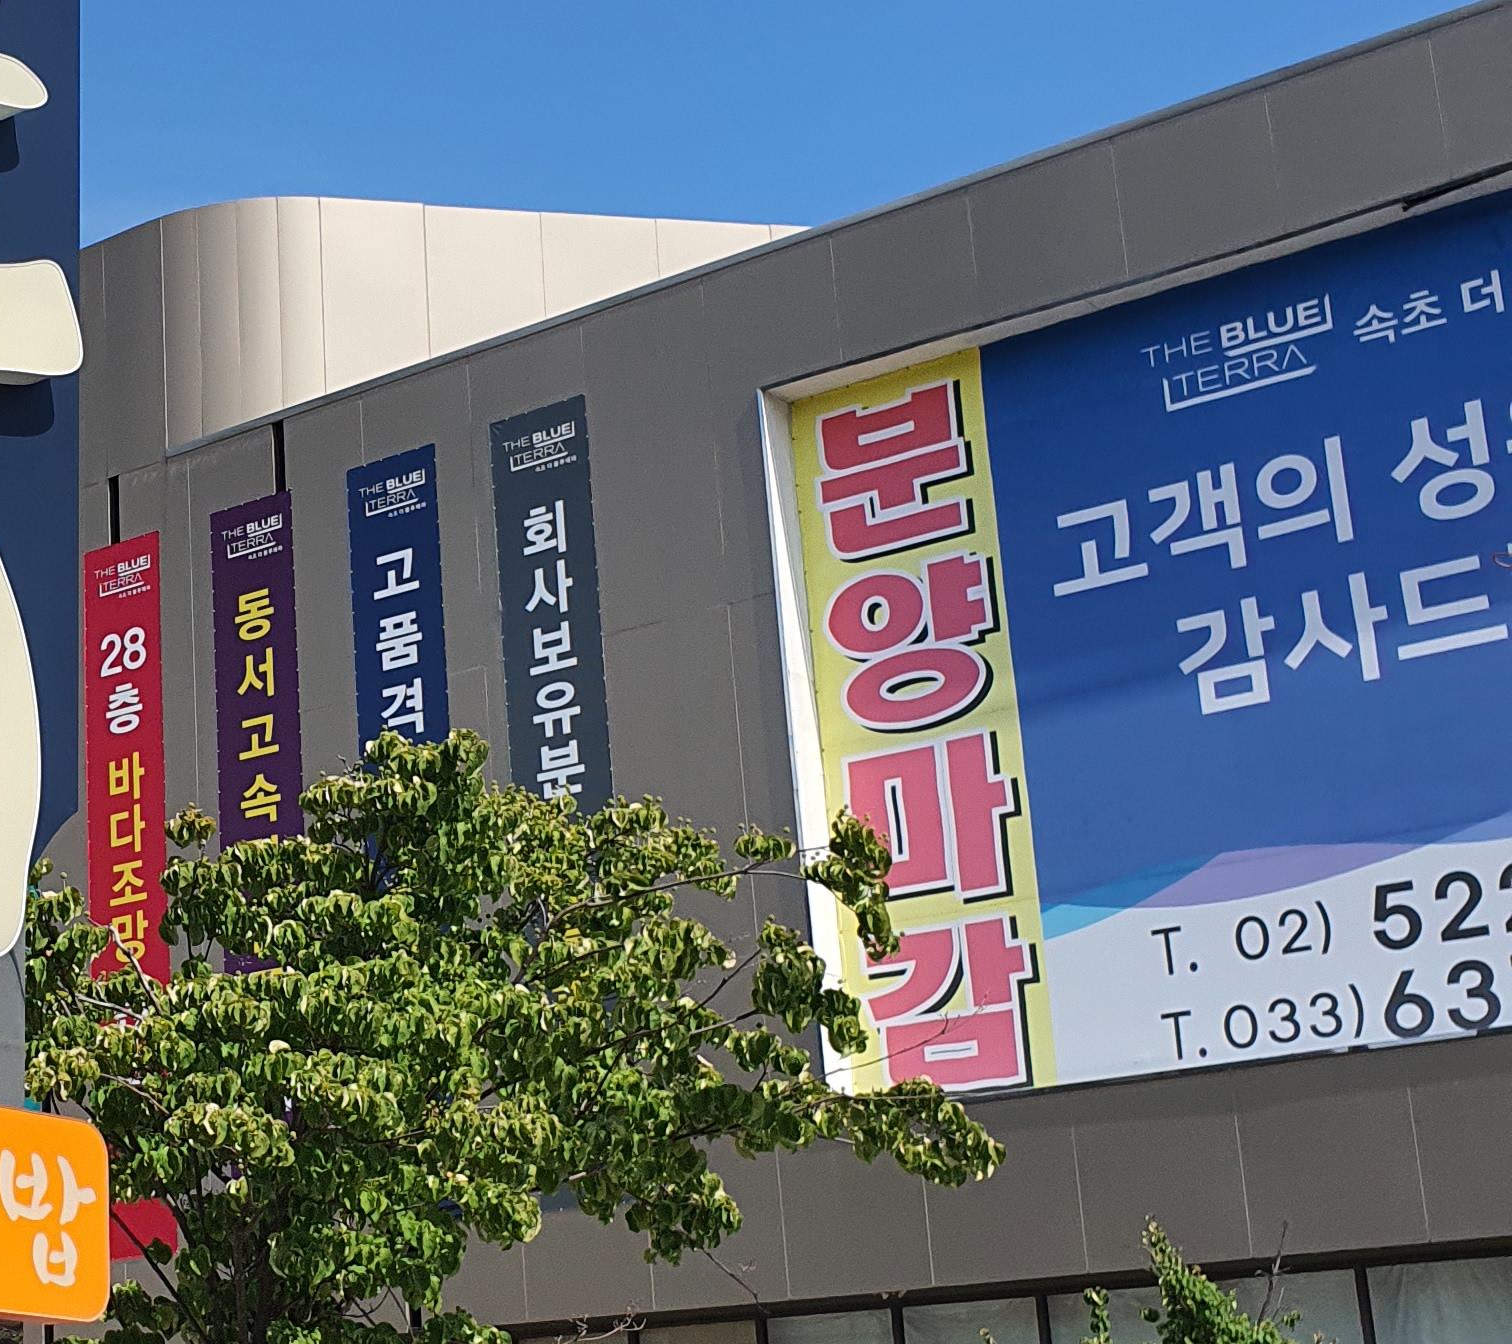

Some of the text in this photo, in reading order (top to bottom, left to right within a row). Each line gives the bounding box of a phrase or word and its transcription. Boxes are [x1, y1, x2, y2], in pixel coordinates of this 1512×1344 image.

[1141, 298, 1321, 367] THE BLUE
[1353, 269, 1505, 343] 속초 더
[1172, 344, 1309, 397] TERRA
[502, 422, 571, 453] THE BLUE
[513, 442, 566, 465] TERRA
[358, 470, 422, 498] THE BLUE
[369, 489, 416, 510] TERRA
[1053, 399, 1512, 597] 고객의 성
[221, 515, 279, 541] THE BLUE
[231, 533, 274, 552] TERRA
[94, 555, 148, 579] THE BLUE
[102, 573, 143, 591] TERRA
[373, 546, 425, 733] 고품격
[522, 499, 586, 800] 회사보유분
[1177, 542, 1512, 715] 감사드
[99, 626, 147, 735] 28층
[815, 378, 1036, 1091] 분양마감
[108, 750, 149, 964] 바다조망
[1373, 863, 1512, 951] 52
